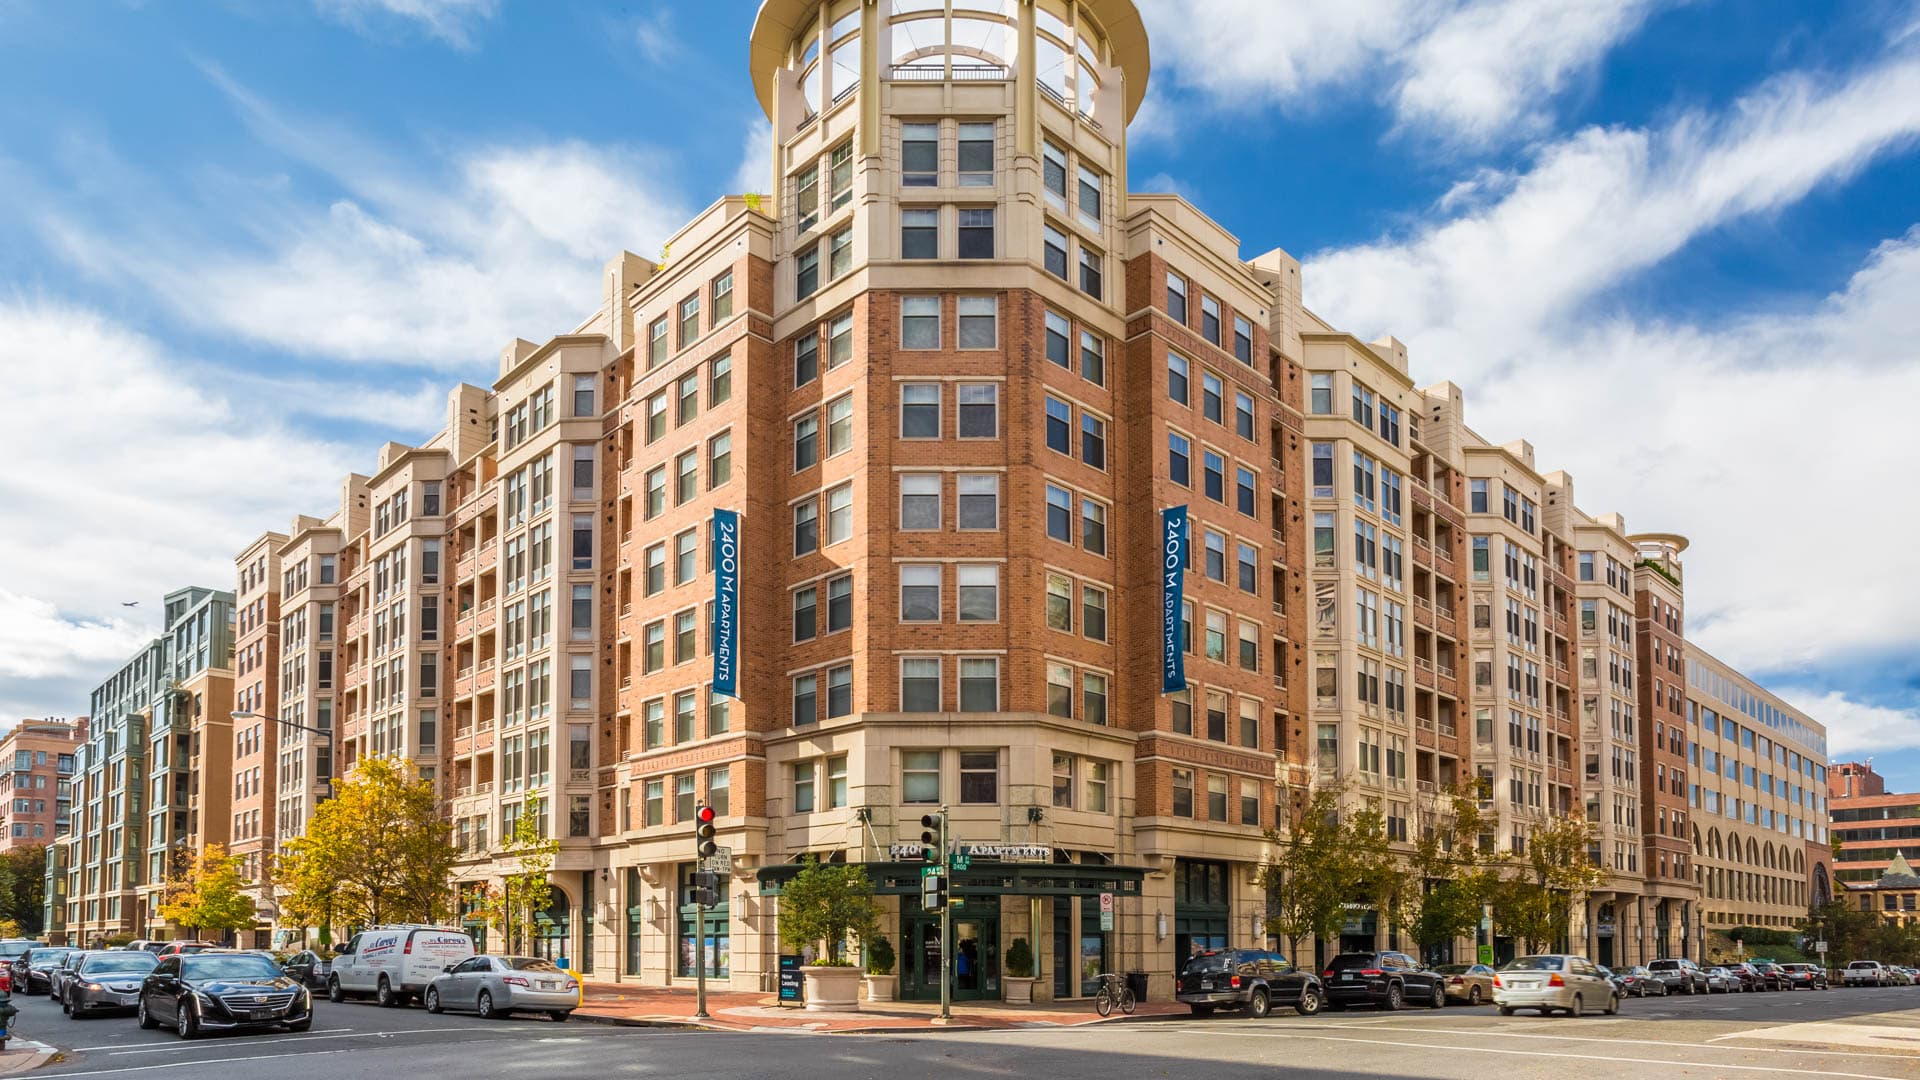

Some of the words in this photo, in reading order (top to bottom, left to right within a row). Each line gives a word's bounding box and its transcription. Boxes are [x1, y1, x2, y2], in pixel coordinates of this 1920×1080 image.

[720, 522, 735, 573] 2400
[1166, 518, 1181, 569] 2400
[721, 575, 735, 592] M
[1166, 572, 1178, 588] M
[718, 594, 732, 681] APARTMENTS
[1164, 592, 1176, 679] APARTMENTS
[891, 845, 921, 857] 240
[968, 845, 1050, 857] APARTMENTS
[956, 855, 963, 864] M
